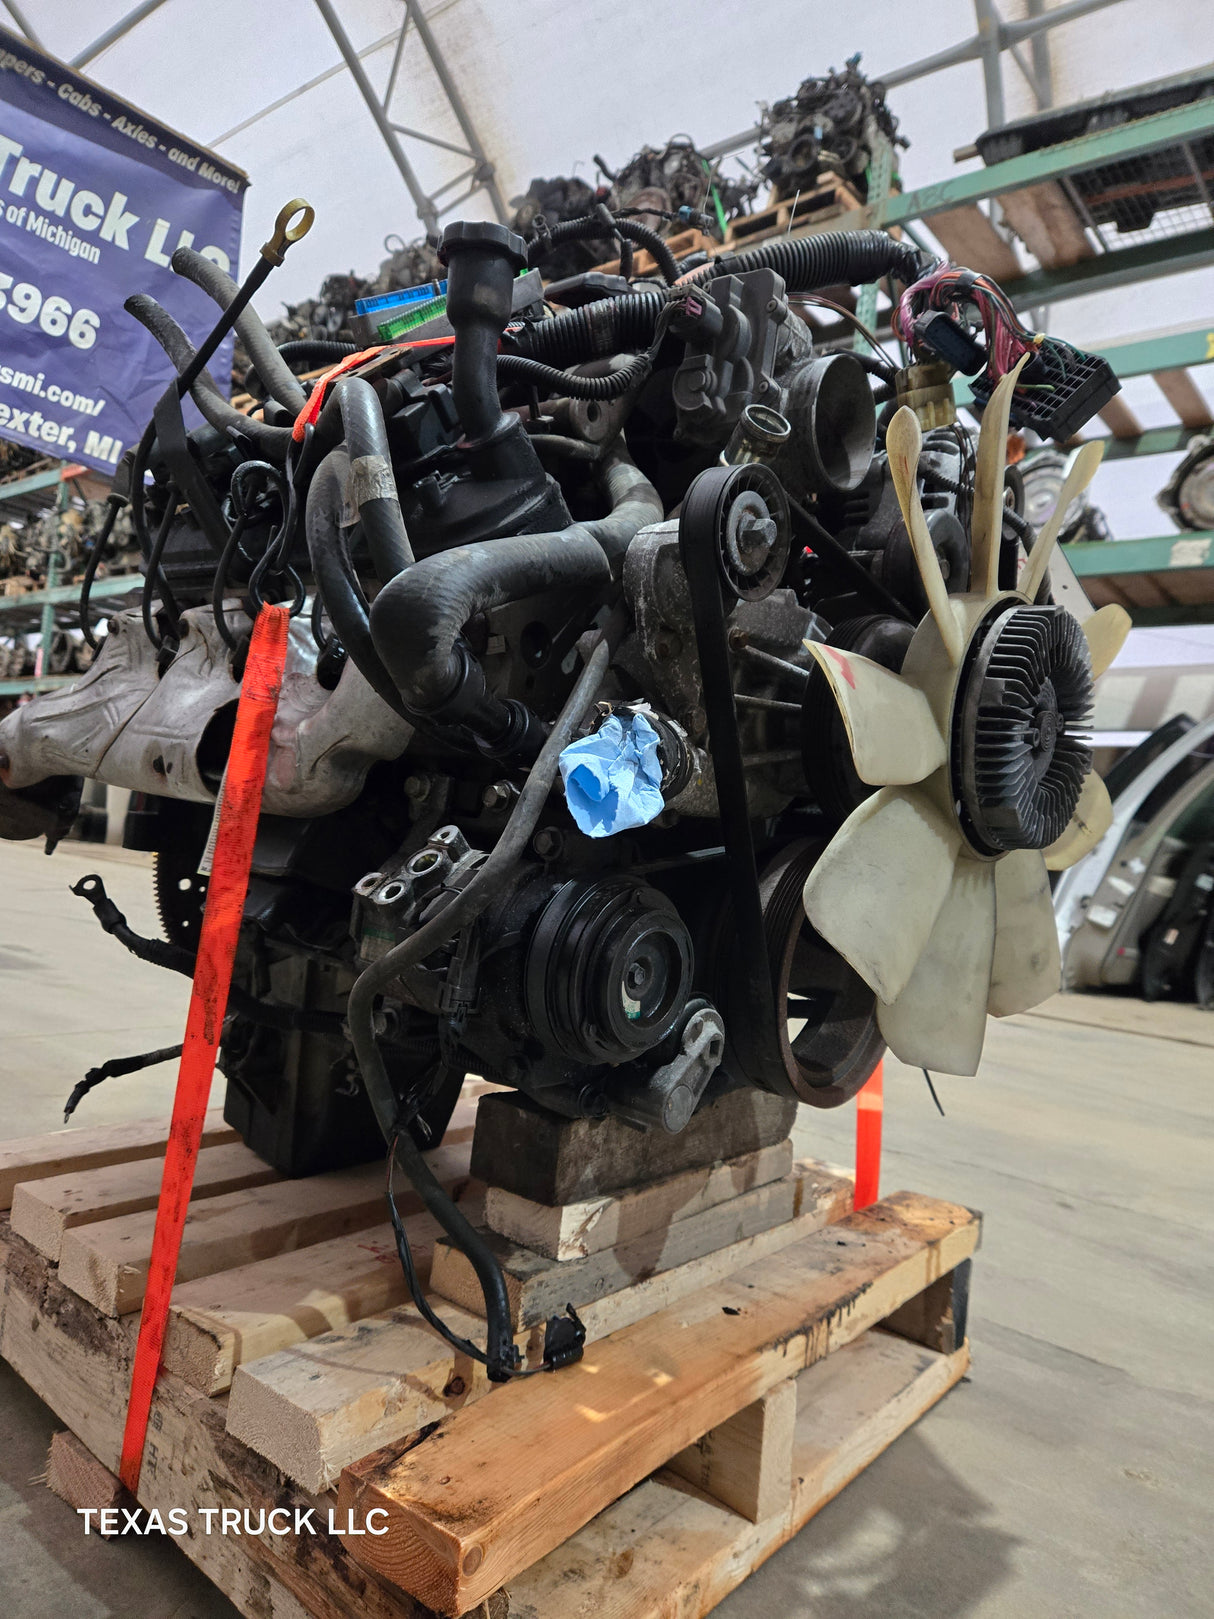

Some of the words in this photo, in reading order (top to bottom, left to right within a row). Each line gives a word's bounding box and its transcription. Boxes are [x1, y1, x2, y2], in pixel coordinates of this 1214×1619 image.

[0, 49, 46, 85] pers
[57, 83, 102, 117] Cabs
[110, 116, 157, 150] Axles
[168, 146, 200, 172] and
[5, 204, 28, 228] of
[25, 210, 101, 265] Michigan
[0, 365, 106, 417] smi.com/
[83, 430, 123, 465] MI
